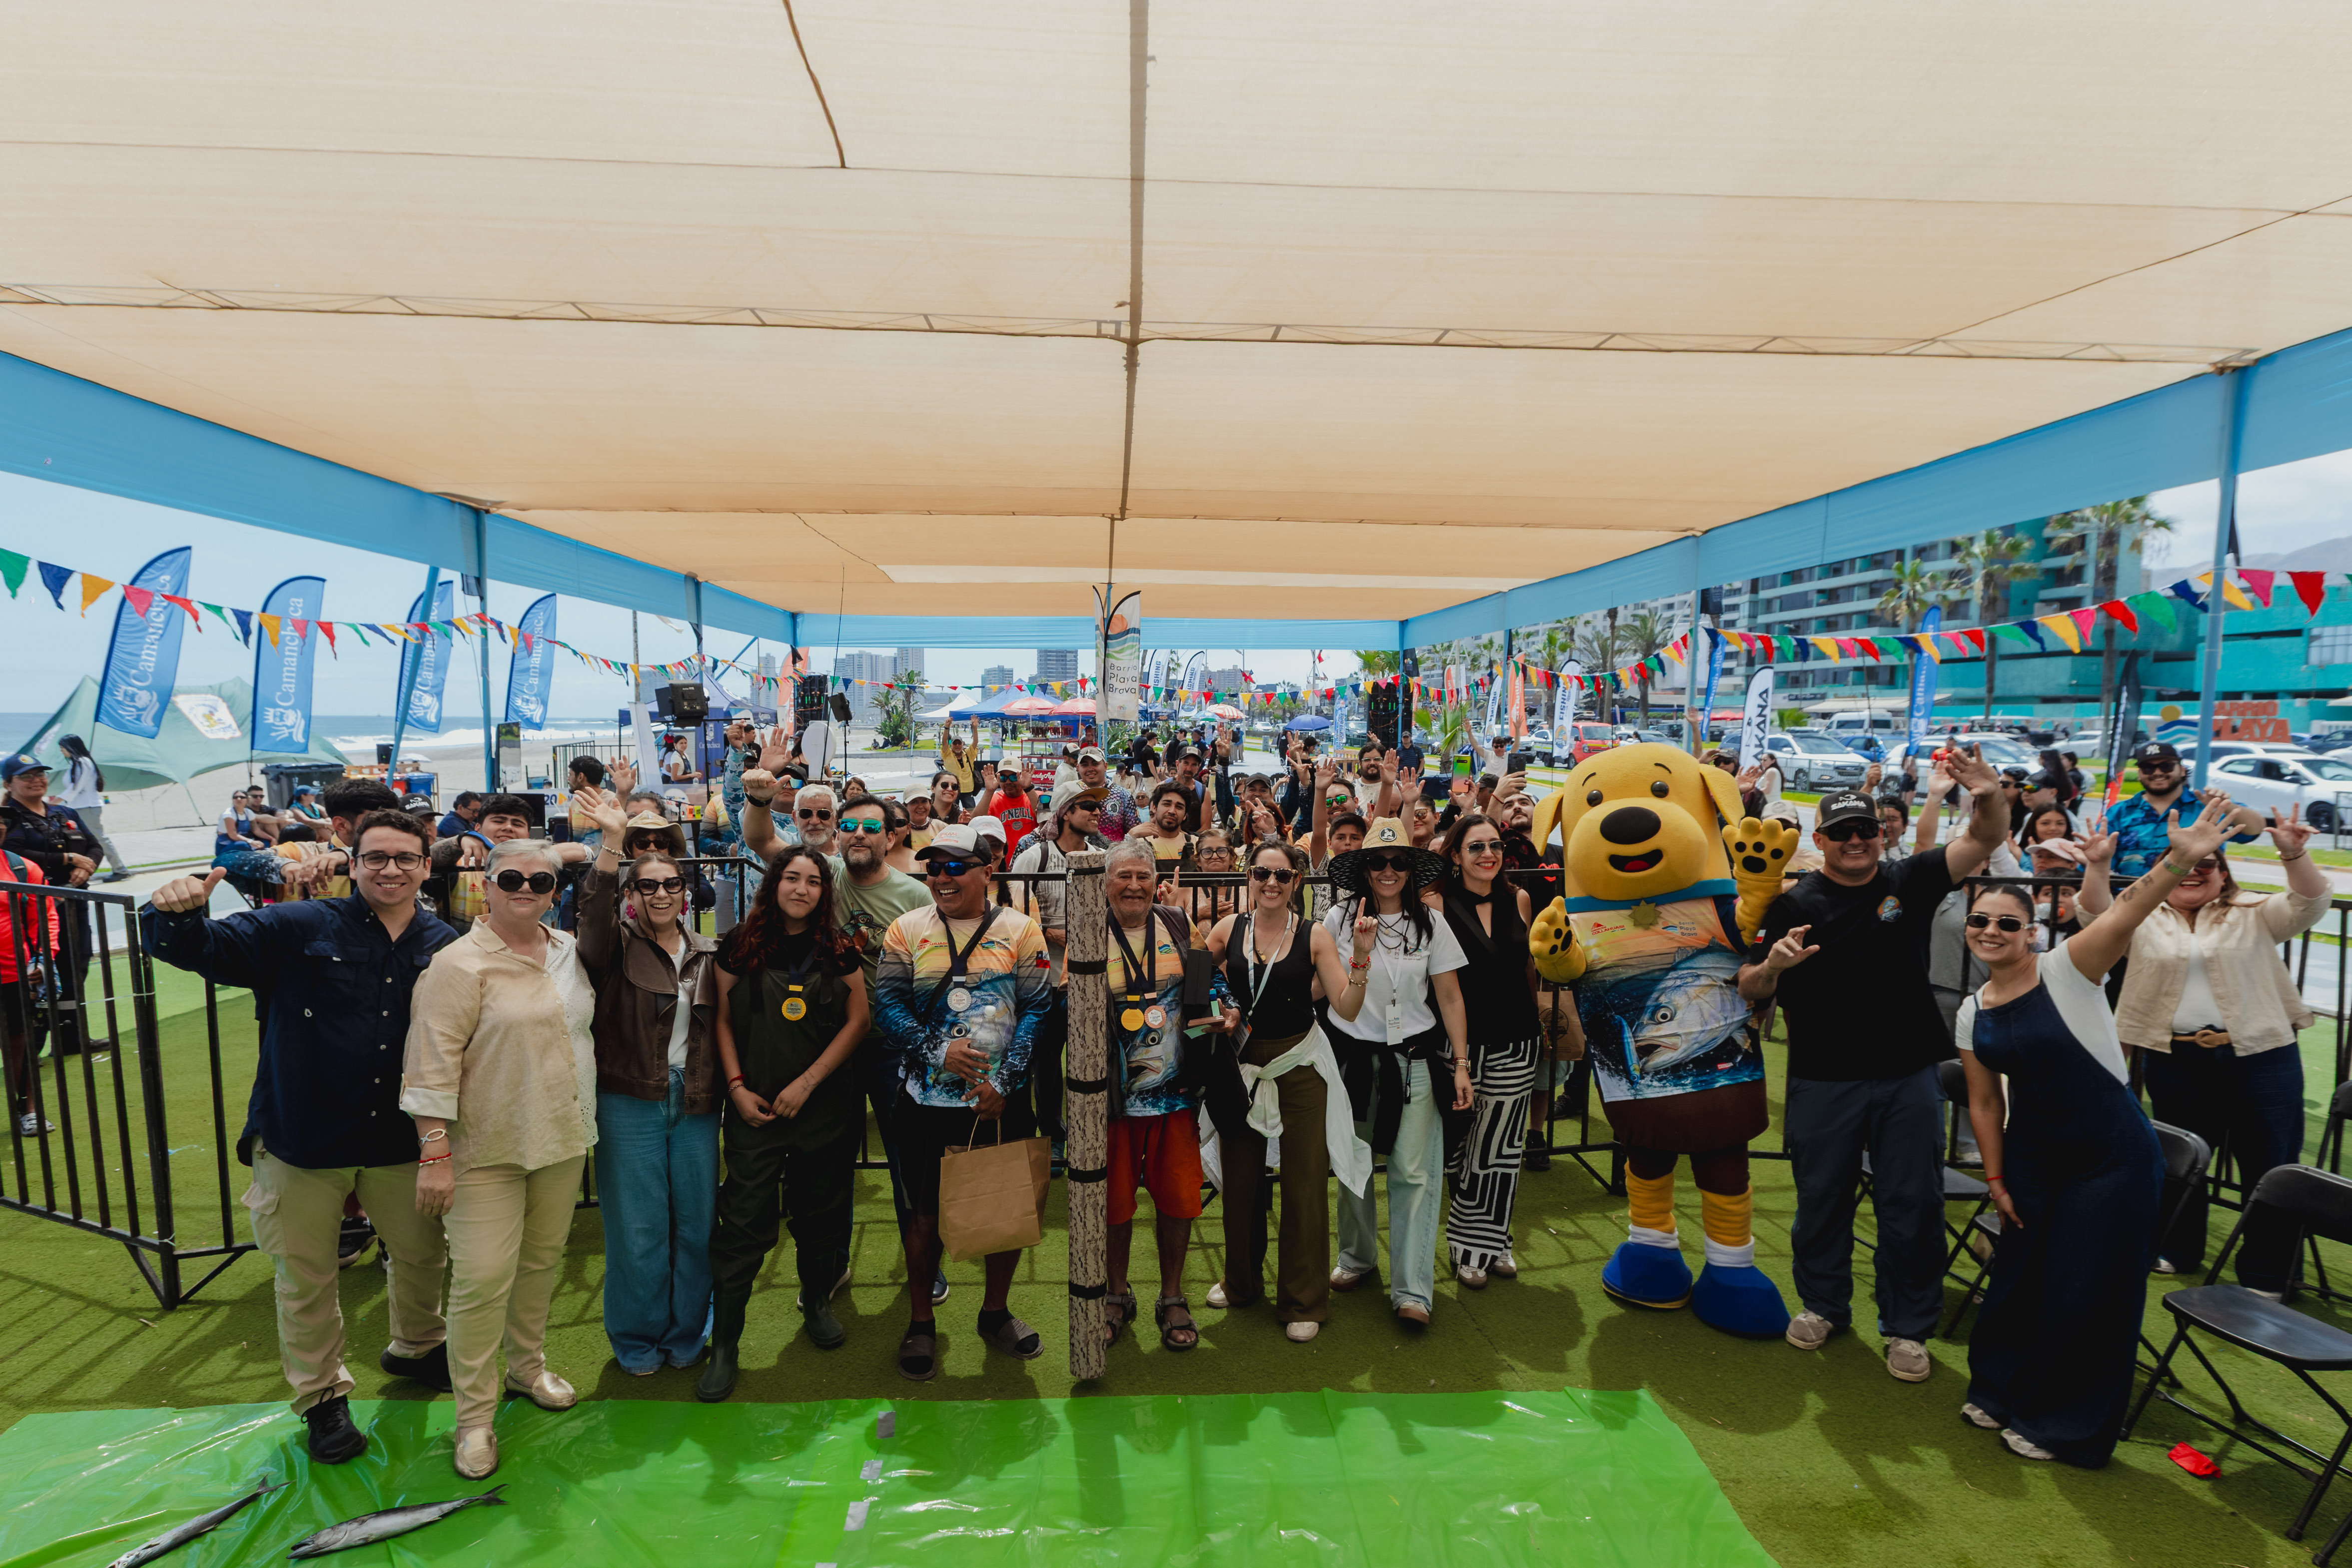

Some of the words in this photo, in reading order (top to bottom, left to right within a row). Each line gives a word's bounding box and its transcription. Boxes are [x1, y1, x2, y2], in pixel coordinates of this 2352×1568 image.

[275, 598, 304, 707] Camanchca
[1109, 673, 1137, 685] Playa
[1108, 683, 1136, 695] Brava
[2214, 701, 2280, 717] ARRIO
[1752, 687, 1770, 763] AKANA
[1830, 800, 1867, 810] SAKANA
[1000, 807, 1033, 823] O'NEILL
[1592, 925, 1625, 935] COLLAHUASI
